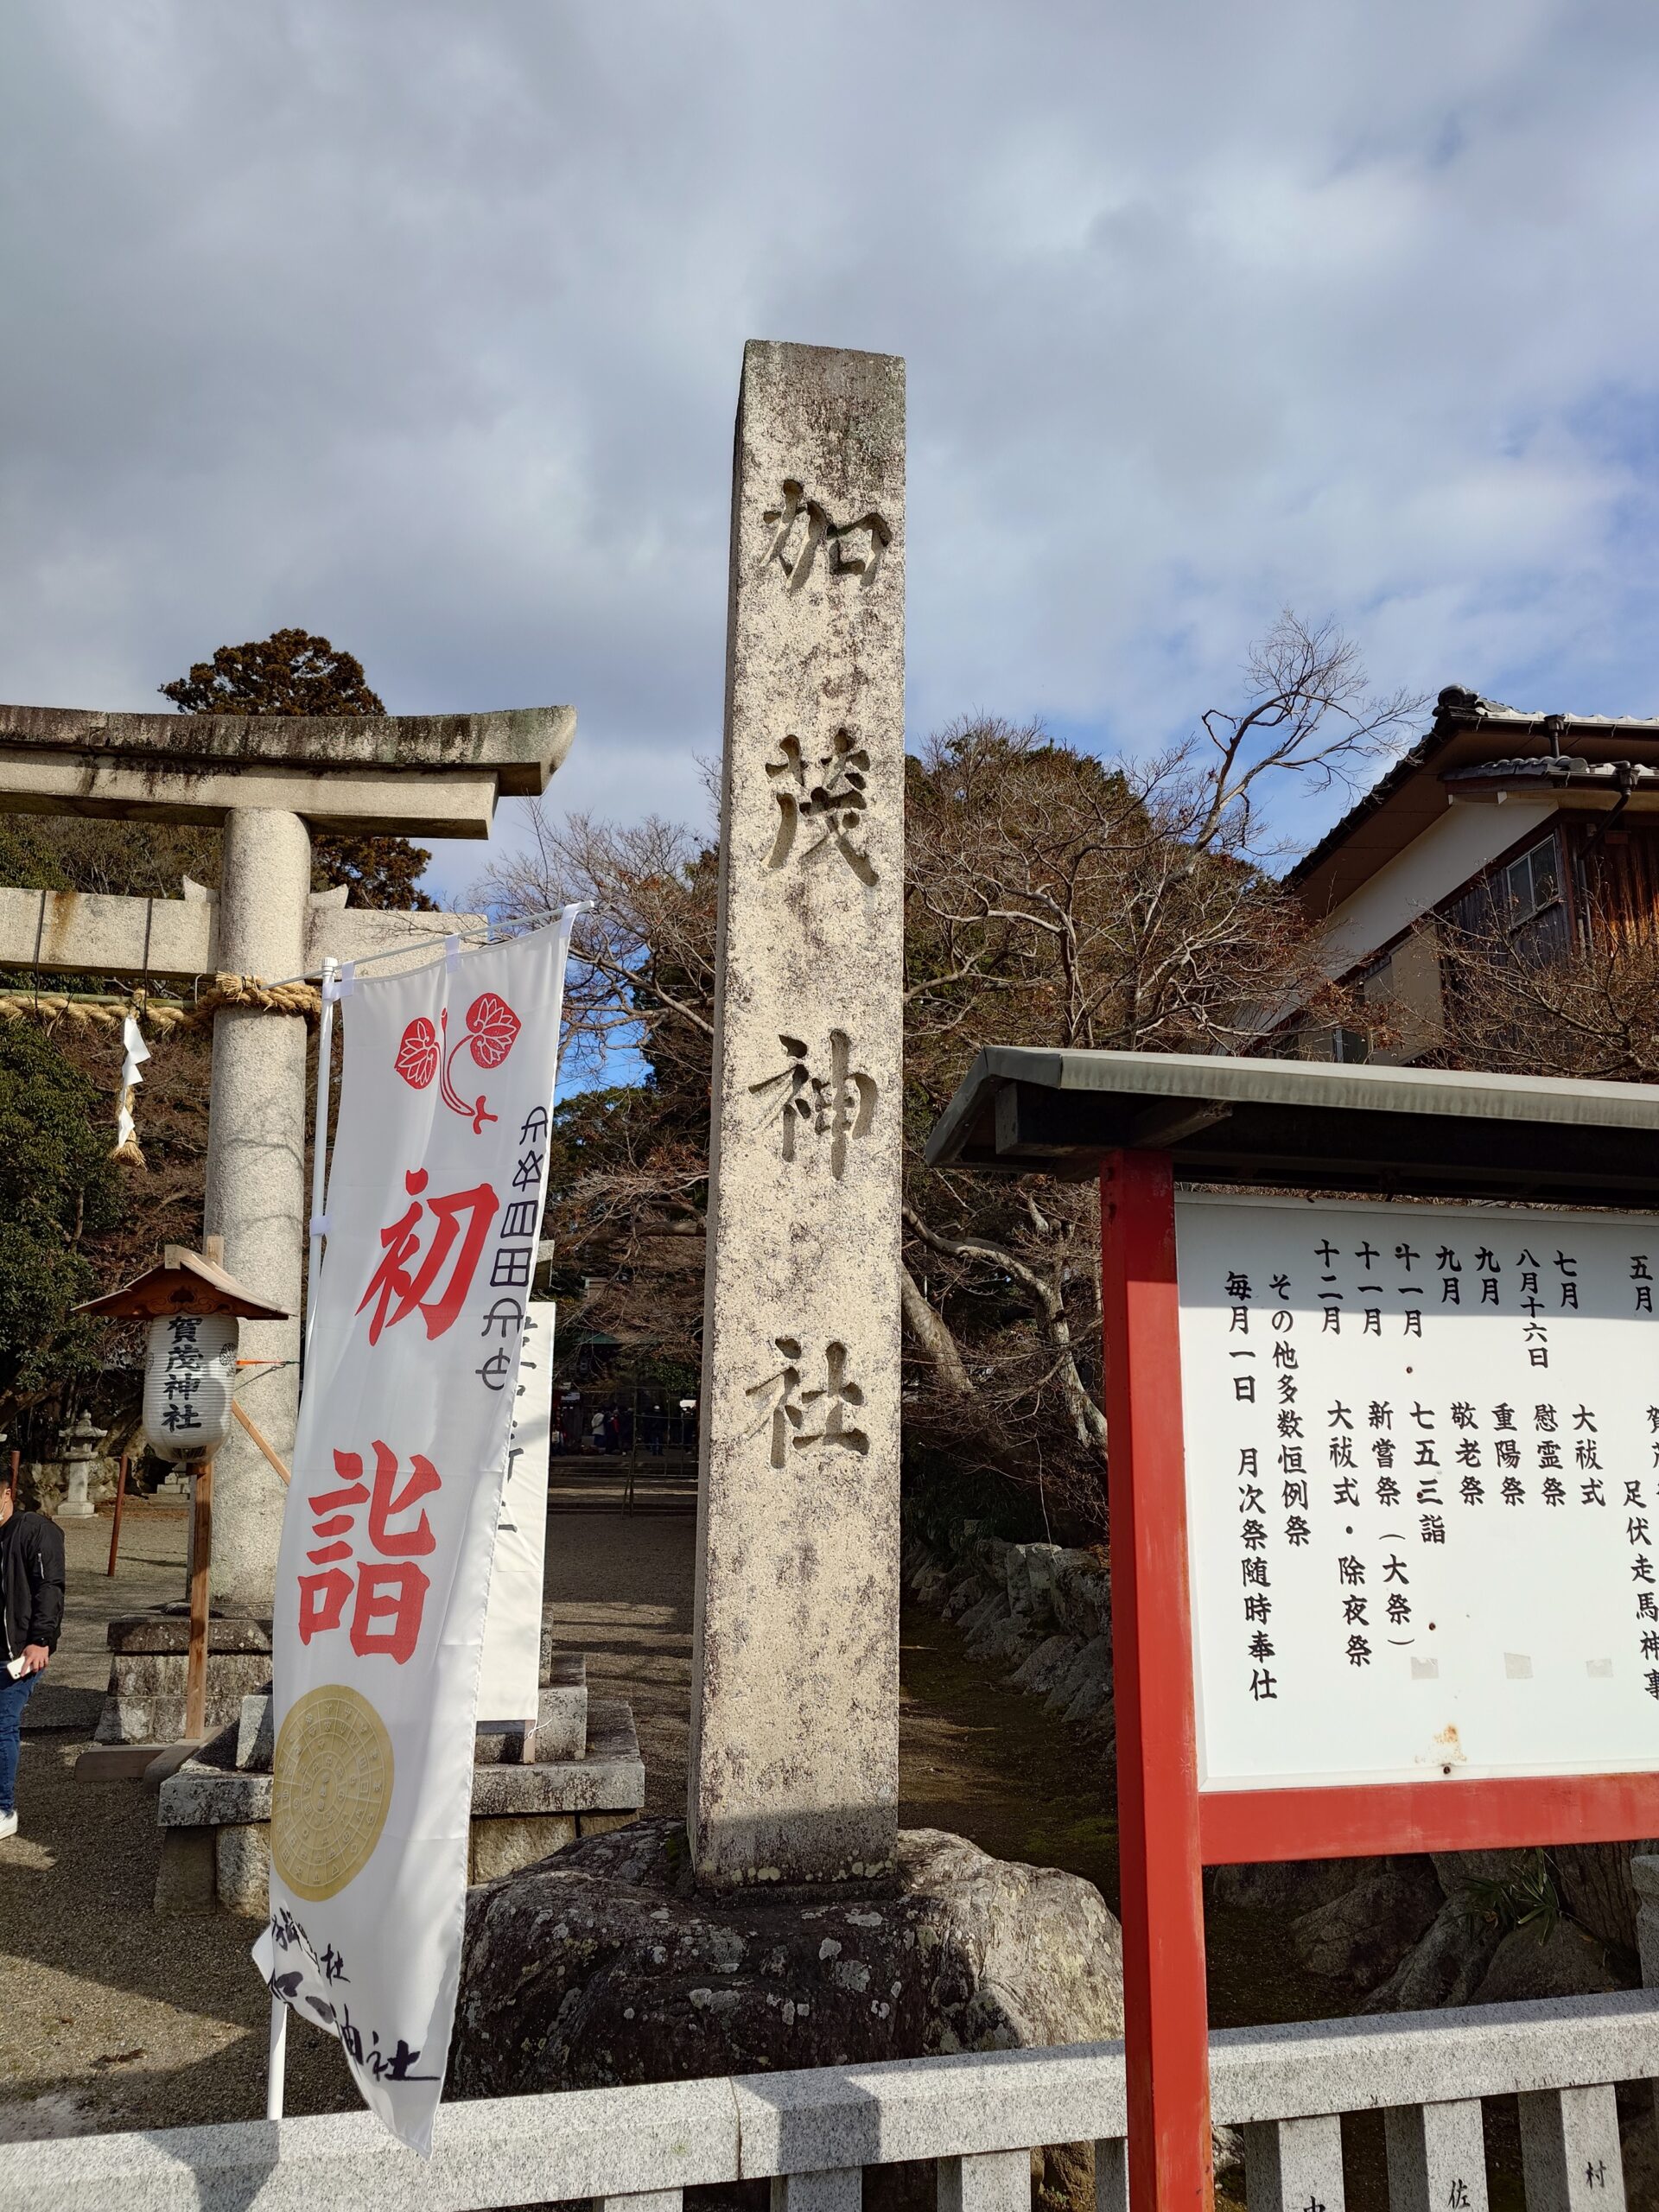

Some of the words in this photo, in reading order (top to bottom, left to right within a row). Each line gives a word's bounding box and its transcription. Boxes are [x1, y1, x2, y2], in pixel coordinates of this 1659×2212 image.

[747, 480, 889, 1470] 加茂神社
[162, 1316, 204, 1432] 賀茂神社
[1224, 1271, 1255, 1403] 毎月一日
[1269, 1274, 1311, 1547] その他多数恒例祭
[1314, 1239, 1343, 1334] 十二月
[1355, 1241, 1382, 1336] 十一月
[1395, 1243, 1423, 1338] 十一月
[1409, 1402, 1445, 1544] 七五三詣
[1435, 1245, 1462, 1305] 九月
[1451, 1402, 1484, 1506] 敬老祭
[1474, 1247, 1501, 1306] 九月
[1491, 1402, 1525, 1506] 重陽祭
[1516, 1249, 1548, 1368] 八月十六日
[1534, 1404, 1566, 1507] 慰霊祭
[1554, 1250, 1578, 1309] 七月
[1573, 1404, 1605, 1506] 大祓式
[1630, 1255, 1653, 1313] 五月
[298, 1168, 499, 1664] 初詣
[1238, 1448, 1278, 1701] 月次祭随時奉仕
